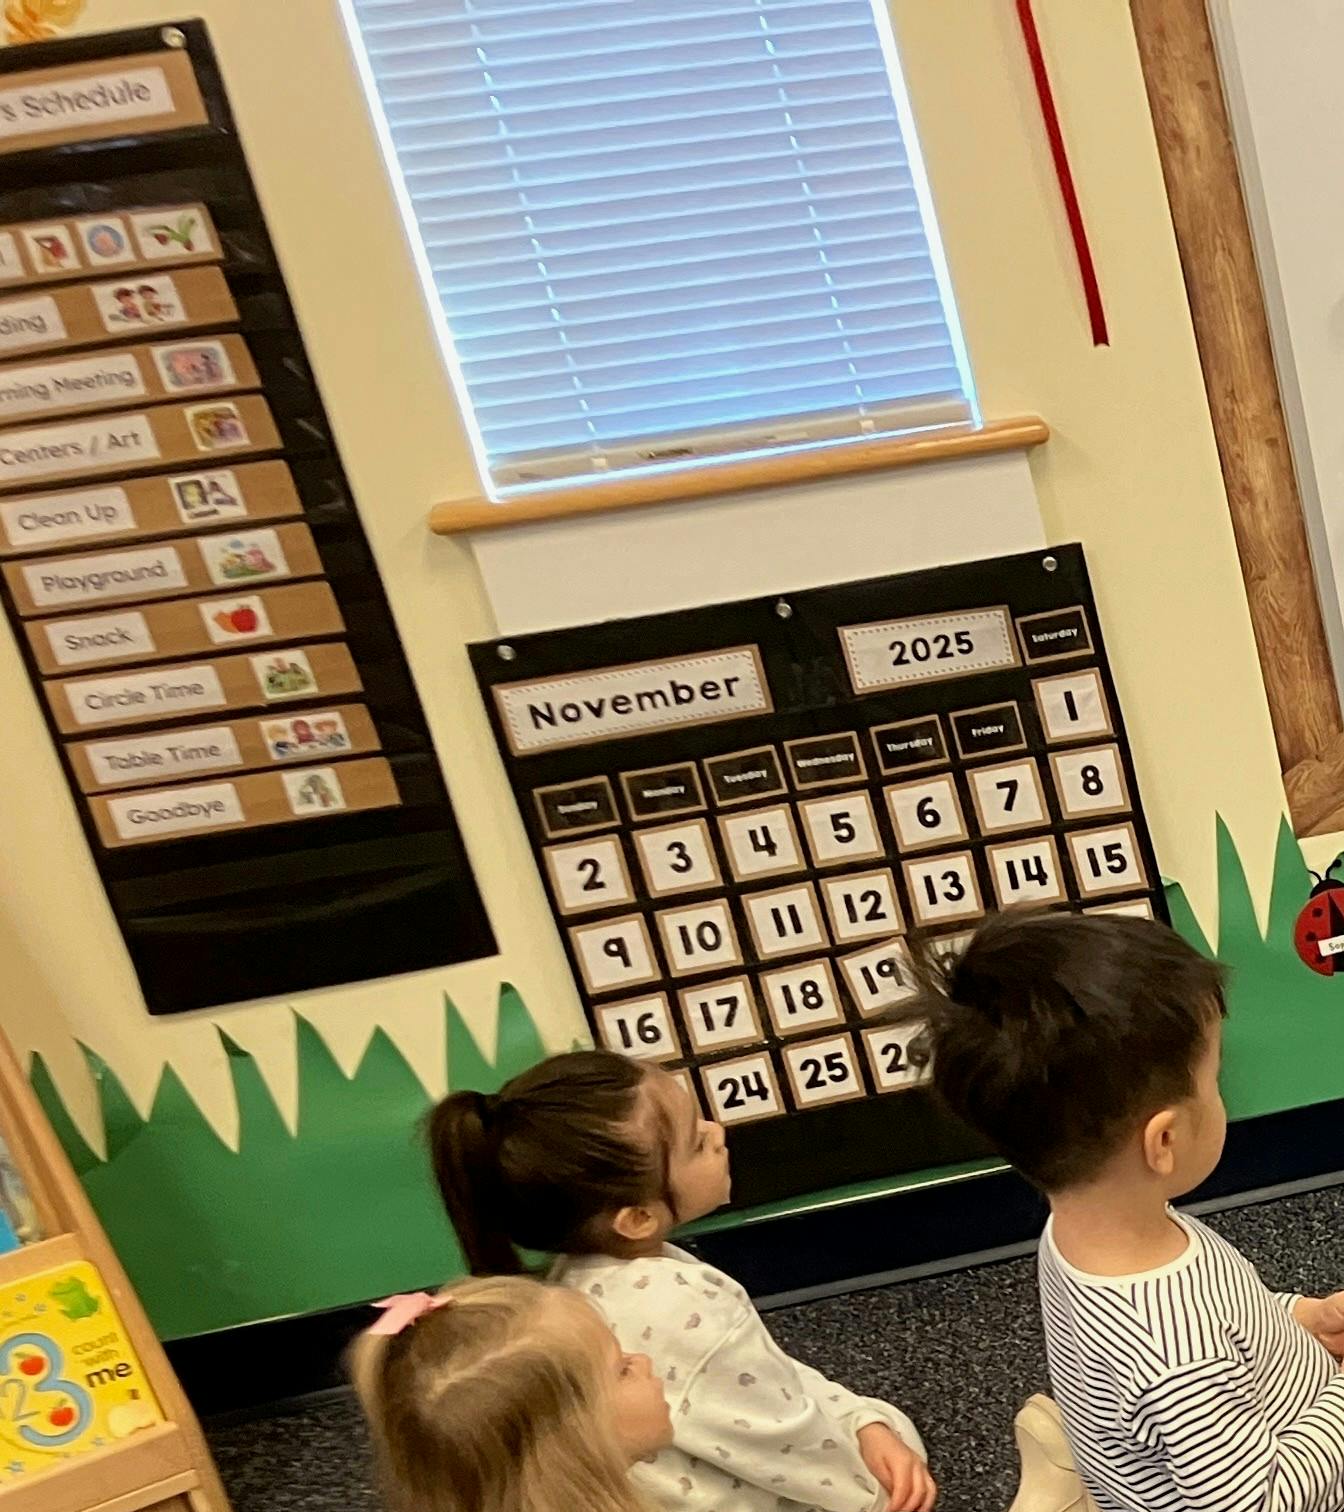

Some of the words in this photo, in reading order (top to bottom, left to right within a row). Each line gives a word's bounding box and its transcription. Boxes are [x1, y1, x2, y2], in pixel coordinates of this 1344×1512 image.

[22, 79, 151, 119] Schedule
[52, 369, 136, 393] Meeting
[0, 441, 83, 466] Centers
[107, 430, 141, 450] Art
[18, 507, 81, 531] Clean
[83, 504, 119, 526] Up
[40, 559, 169, 592] Playground
[63, 626, 135, 651] Snack
[84, 688, 147, 711] Circle
[148, 681, 206, 702] Time
[526, 675, 741, 730] November
[889, 631, 973, 665] 2025
[886, 735, 934, 752] Thursday
[971, 724, 1005, 738] Friday
[1031, 626, 1078, 644] Saturday
[1064, 691, 1078, 721] 1
[103, 750, 164, 771] Table
[166, 743, 223, 764] Time
[126, 799, 226, 825] Goodbye
[578, 859, 605, 891] 2
[667, 842, 692, 873] 3
[749, 826, 776, 856] 4
[830, 812, 855, 843] 5
[917, 797, 940, 828] 6
[996, 780, 1018, 811] 7
[1081, 765, 1103, 795] 8
[604, 937, 631, 967] 9
[679, 921, 721, 955] 10
[771, 905, 803, 937] 11
[844, 891, 886, 923] 12
[924, 871, 965, 905] 13
[1006, 856, 1047, 890] 14
[1086, 843, 1128, 878] 15
[616, 1012, 663, 1049] 16
[699, 995, 739, 1032] 17
[782, 980, 823, 1014] 18
[859, 957, 905, 996] 19
[717, 1070, 770, 1110] 24
[799, 1051, 849, 1090] 25
[86, 1362, 132, 1389] me
